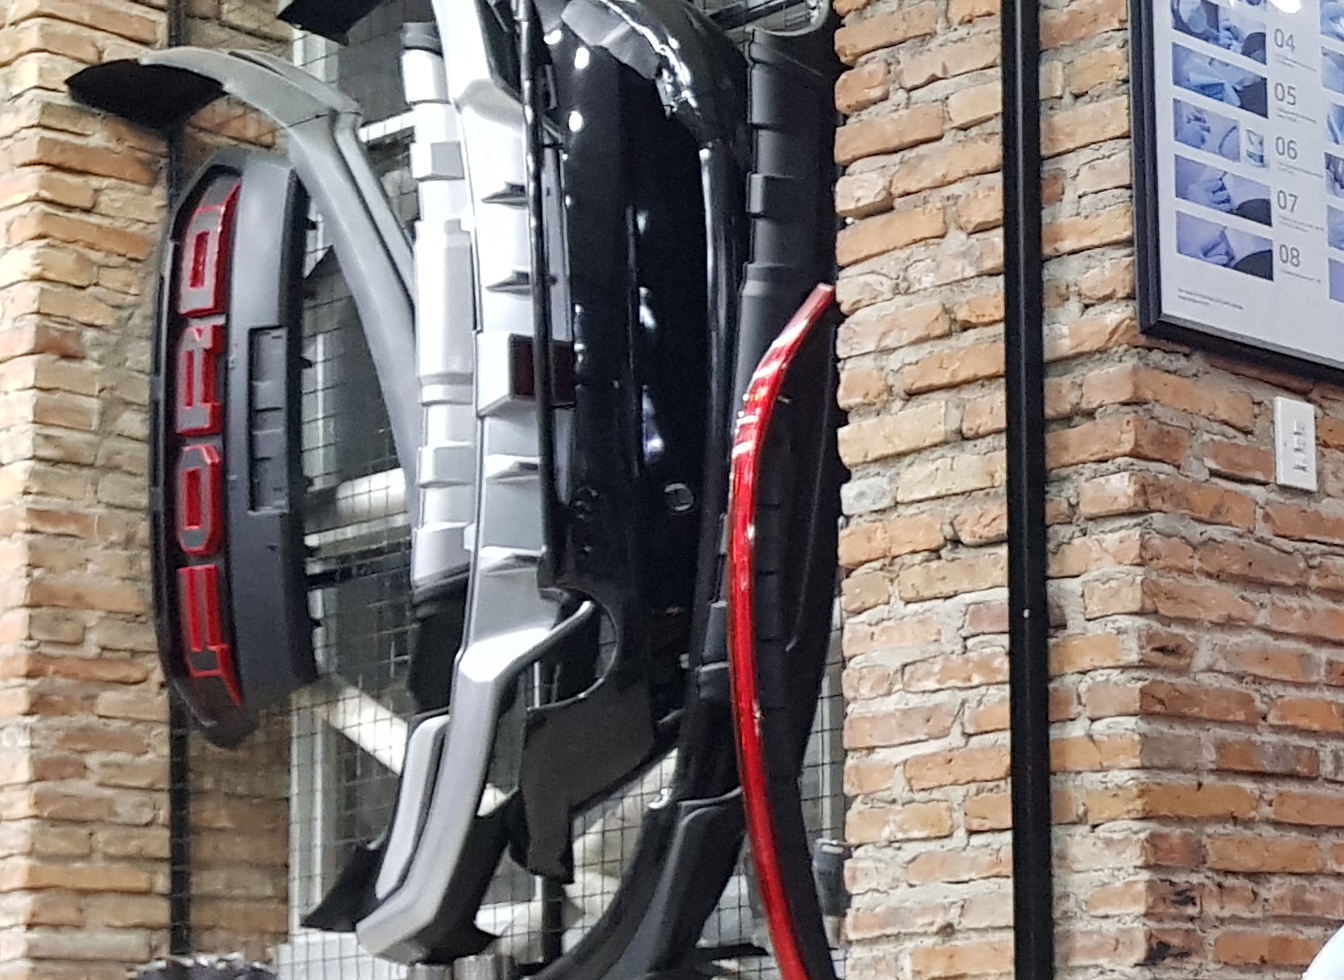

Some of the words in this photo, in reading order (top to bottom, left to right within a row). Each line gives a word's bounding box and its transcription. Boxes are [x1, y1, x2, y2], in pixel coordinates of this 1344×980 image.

[1274, 28, 1296, 53] 04
[1274, 82, 1297, 106] 05
[1275, 136, 1298, 160] 06
[1277, 190, 1298, 213] 07
[1279, 243, 1301, 267] 08
[176, 175, 242, 704] FORD
